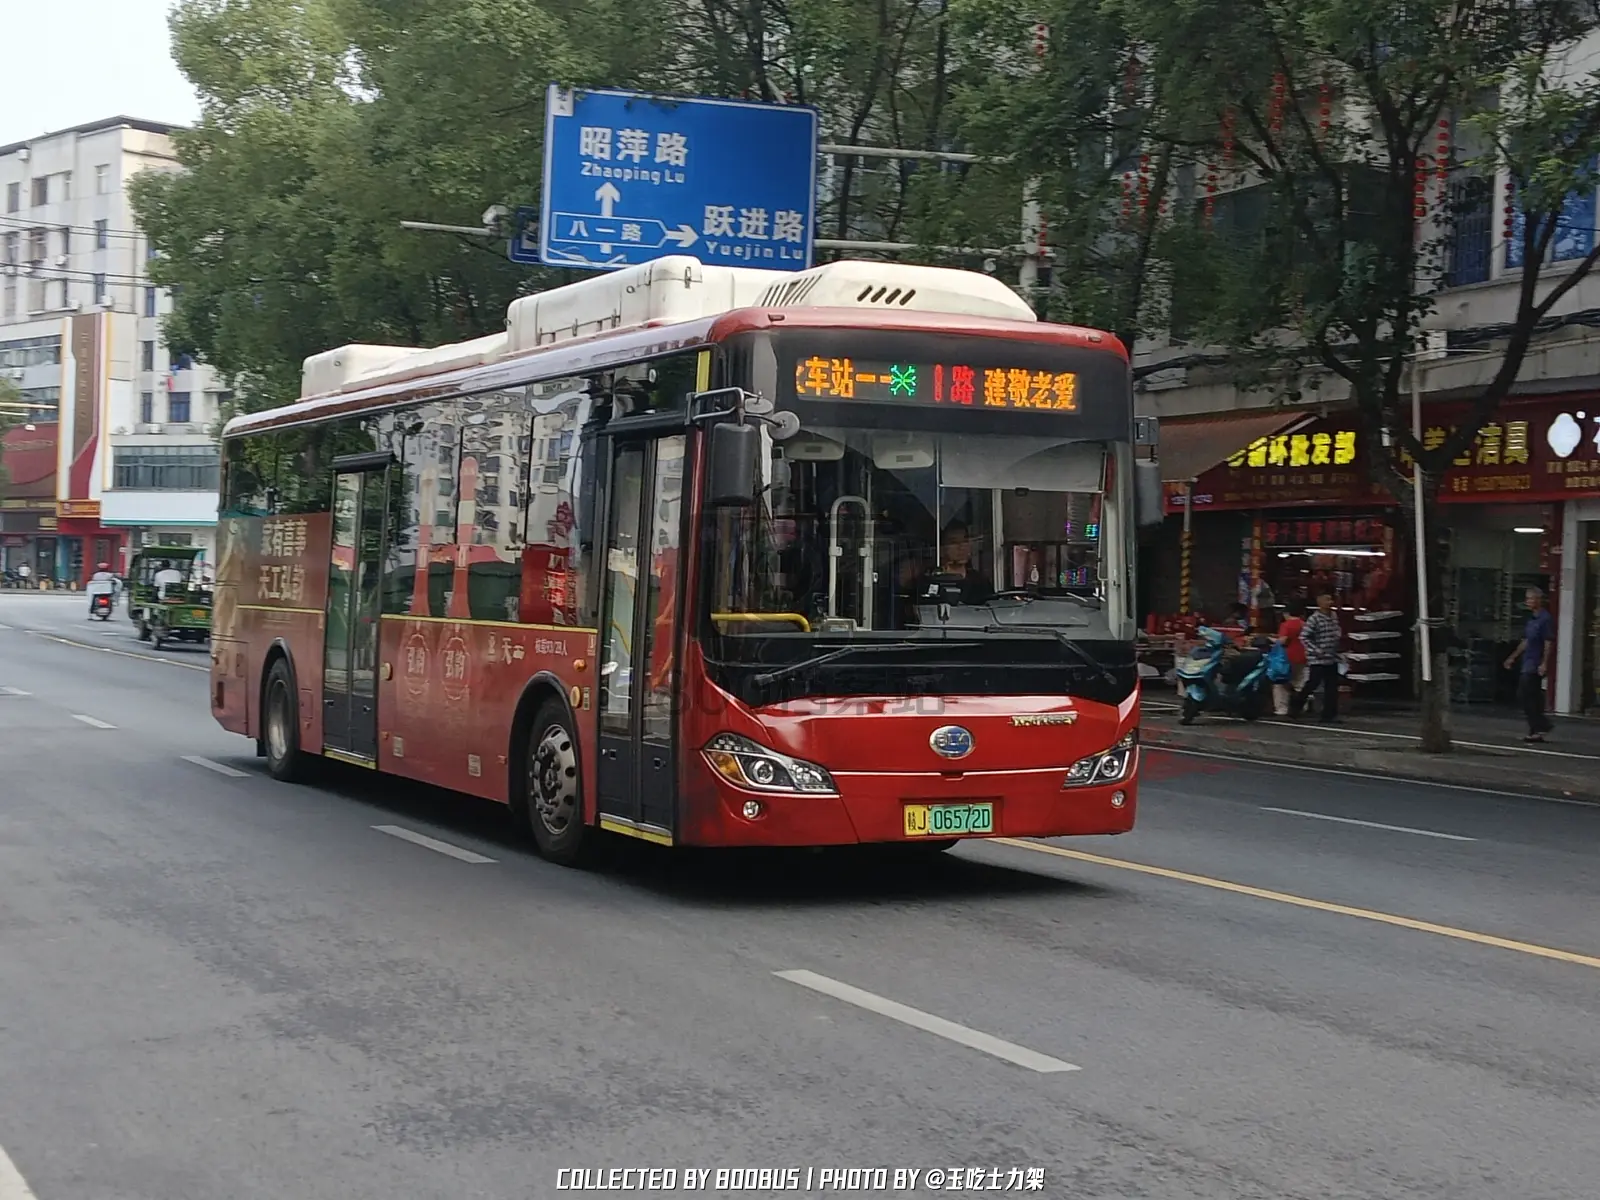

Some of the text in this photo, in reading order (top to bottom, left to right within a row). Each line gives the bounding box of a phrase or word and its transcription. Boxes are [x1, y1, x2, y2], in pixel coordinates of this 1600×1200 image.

[579, 126, 689, 167] 昭萍路
[580, 161, 685, 185] Zhaoping Lu
[568, 219, 642, 243] 八一路
[702, 204, 805, 243] 跃进路
[705, 240, 804, 260] Yuejin Lu
